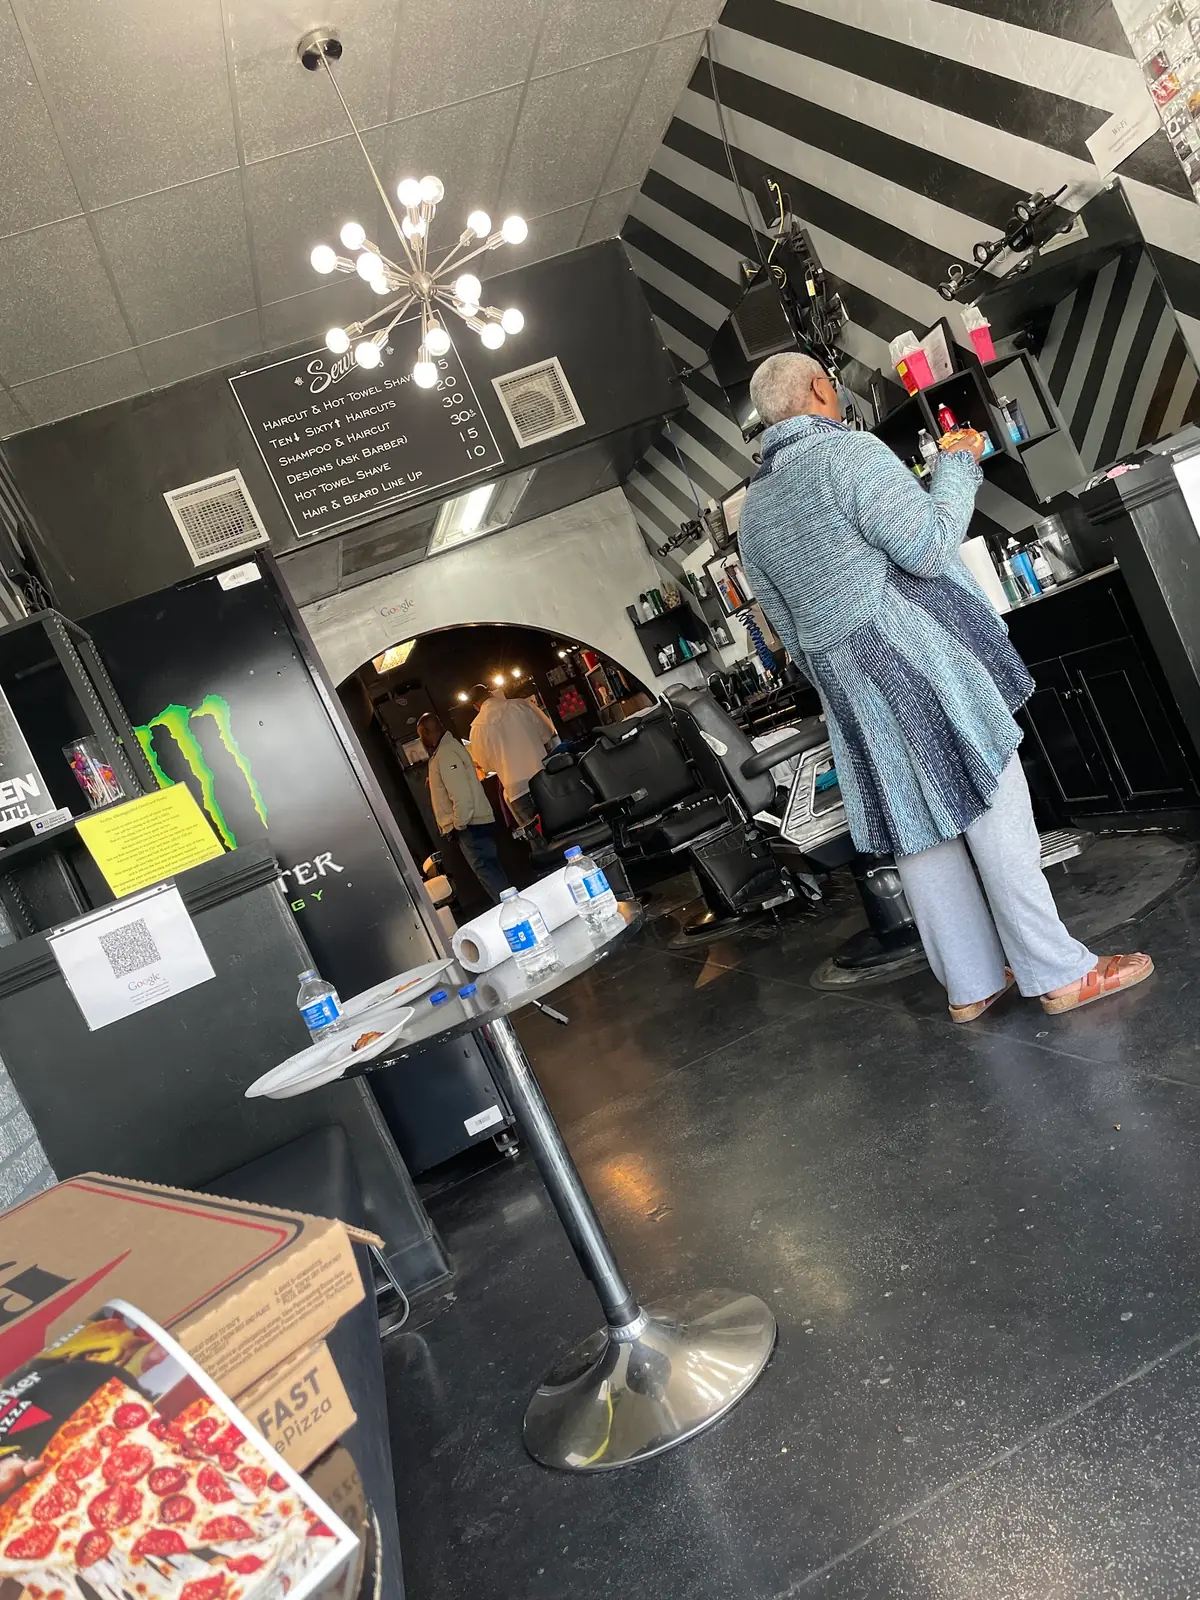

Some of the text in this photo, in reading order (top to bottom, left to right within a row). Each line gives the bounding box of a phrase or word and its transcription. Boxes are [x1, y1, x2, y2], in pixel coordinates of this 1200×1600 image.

[306, 345, 385, 394] Servi
[263, 410, 308, 431] HAIRCUT
[311, 405, 322, 415] &
[323, 397, 345, 410] HOT
[347, 386, 382, 402] TOWEL
[270, 376, 456, 449] TEN SIXTY HAIRCUTS 20
[278, 393, 464, 467] SHAMPOO & HAIRCUT 30
[287, 463, 333, 485] DESIGNS
[336, 454, 360, 468] (ASK
[362, 435, 408, 458] BARBER)
[450, 410, 470, 425] 30
[294, 427, 478, 502] HOT TOWEL SHAVE 15
[302, 445, 486, 520] HAIR & BEARD LINE UP 10
[380, 599, 415, 617] Google
[127, 973, 161, 992] Google
[258, 1367, 322, 1441] FAST
